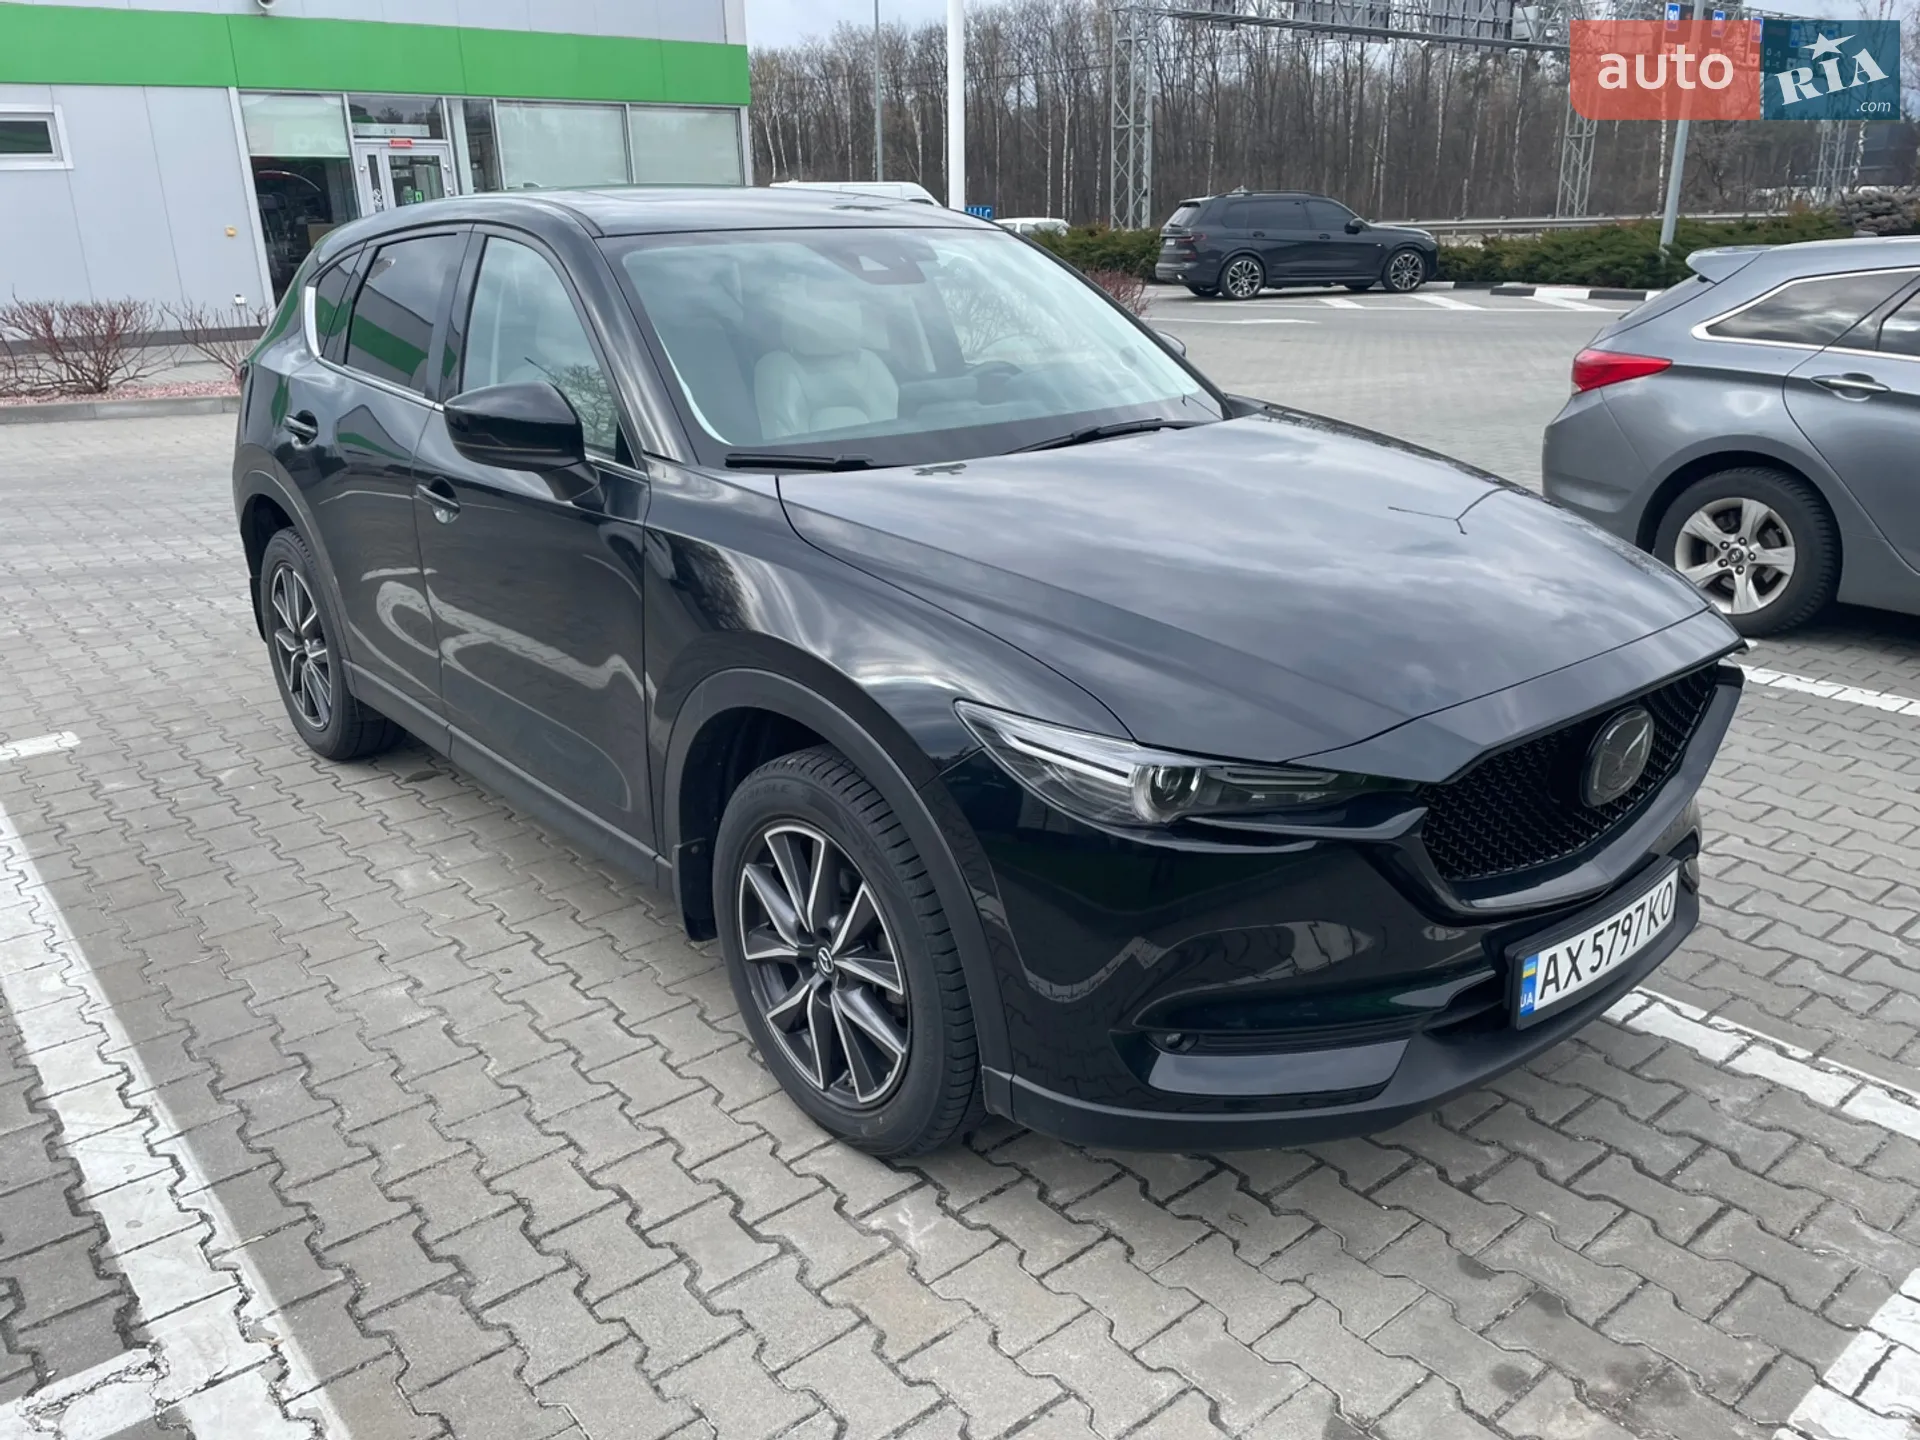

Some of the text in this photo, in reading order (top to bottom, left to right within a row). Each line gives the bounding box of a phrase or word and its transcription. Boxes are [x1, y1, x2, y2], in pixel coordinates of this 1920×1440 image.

[1539, 881, 1673, 1001] AX 5797 KO
